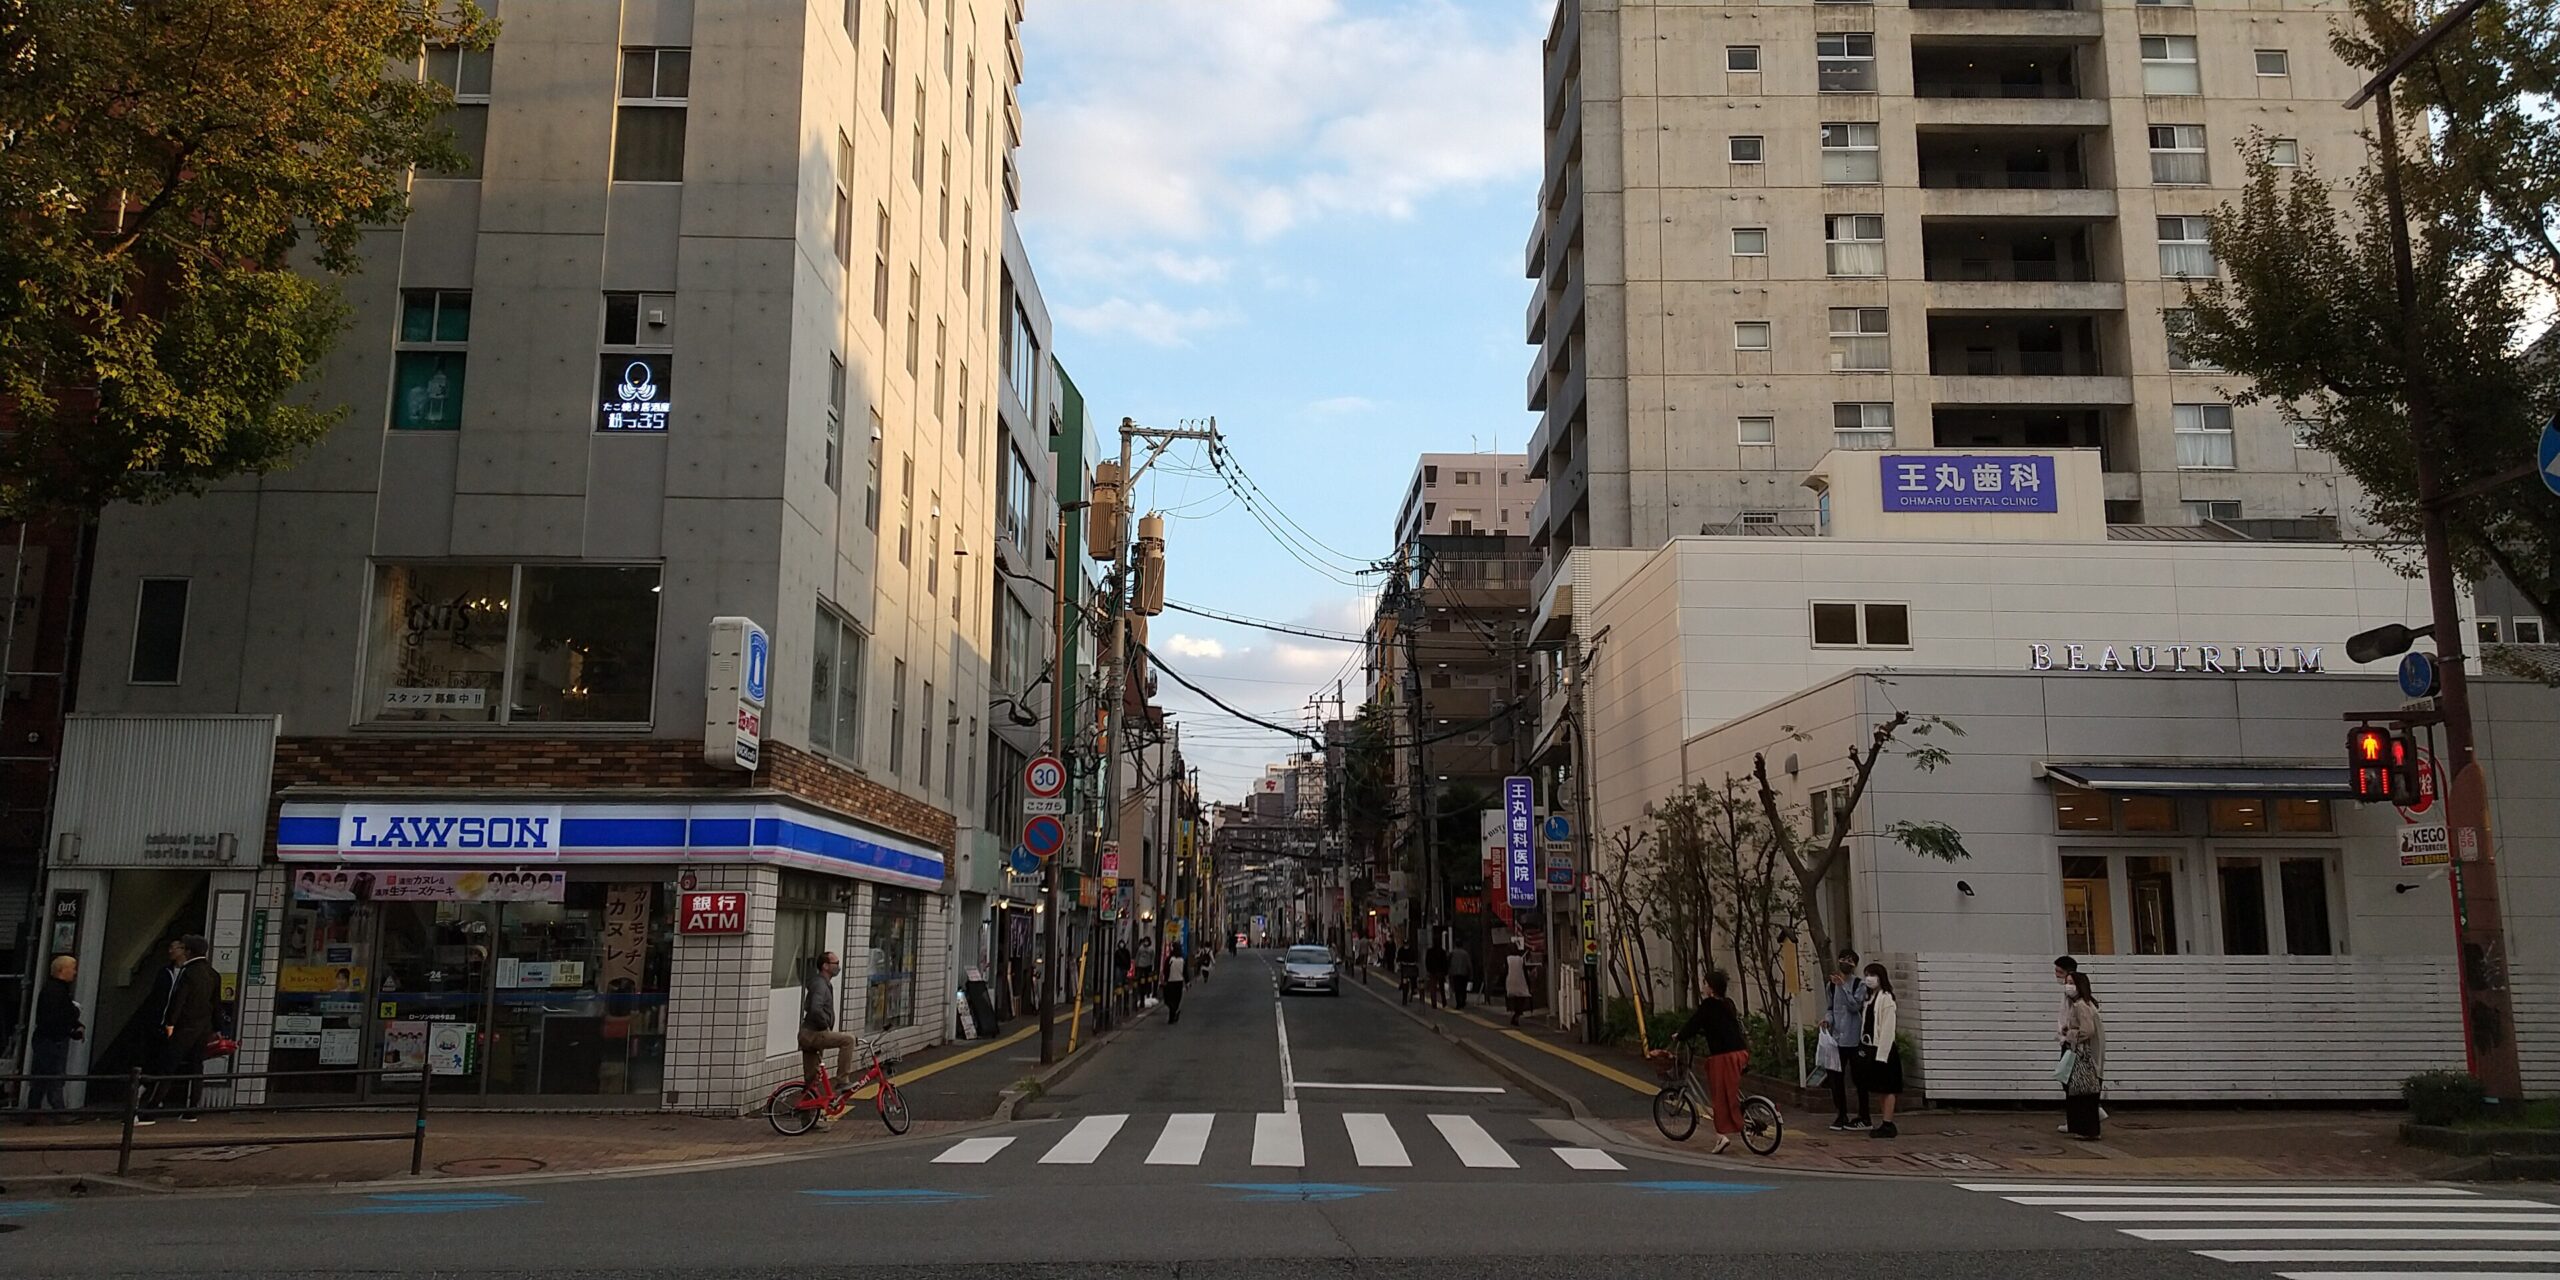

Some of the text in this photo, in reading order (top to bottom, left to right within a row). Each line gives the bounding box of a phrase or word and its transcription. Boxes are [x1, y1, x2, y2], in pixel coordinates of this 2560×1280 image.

[1897, 463, 2041, 492] 王丸歯科
[1900, 496, 2039, 506] OHMARU DENTAL CLINIC
[2030, 643, 2325, 674] BEAUTRIUM
[1034, 768, 1057, 786] 30
[1027, 801, 1063, 811] ここから
[350, 816, 550, 848] LAWSON
[1511, 783, 1530, 882] 王丸歯科医院
[2413, 827, 2446, 844] KEGO
[692, 895, 737, 911] 銀行
[607, 898, 626, 961] カヌレ
[687, 913, 738, 930] ATM
[430, 970, 441, 979] 24
